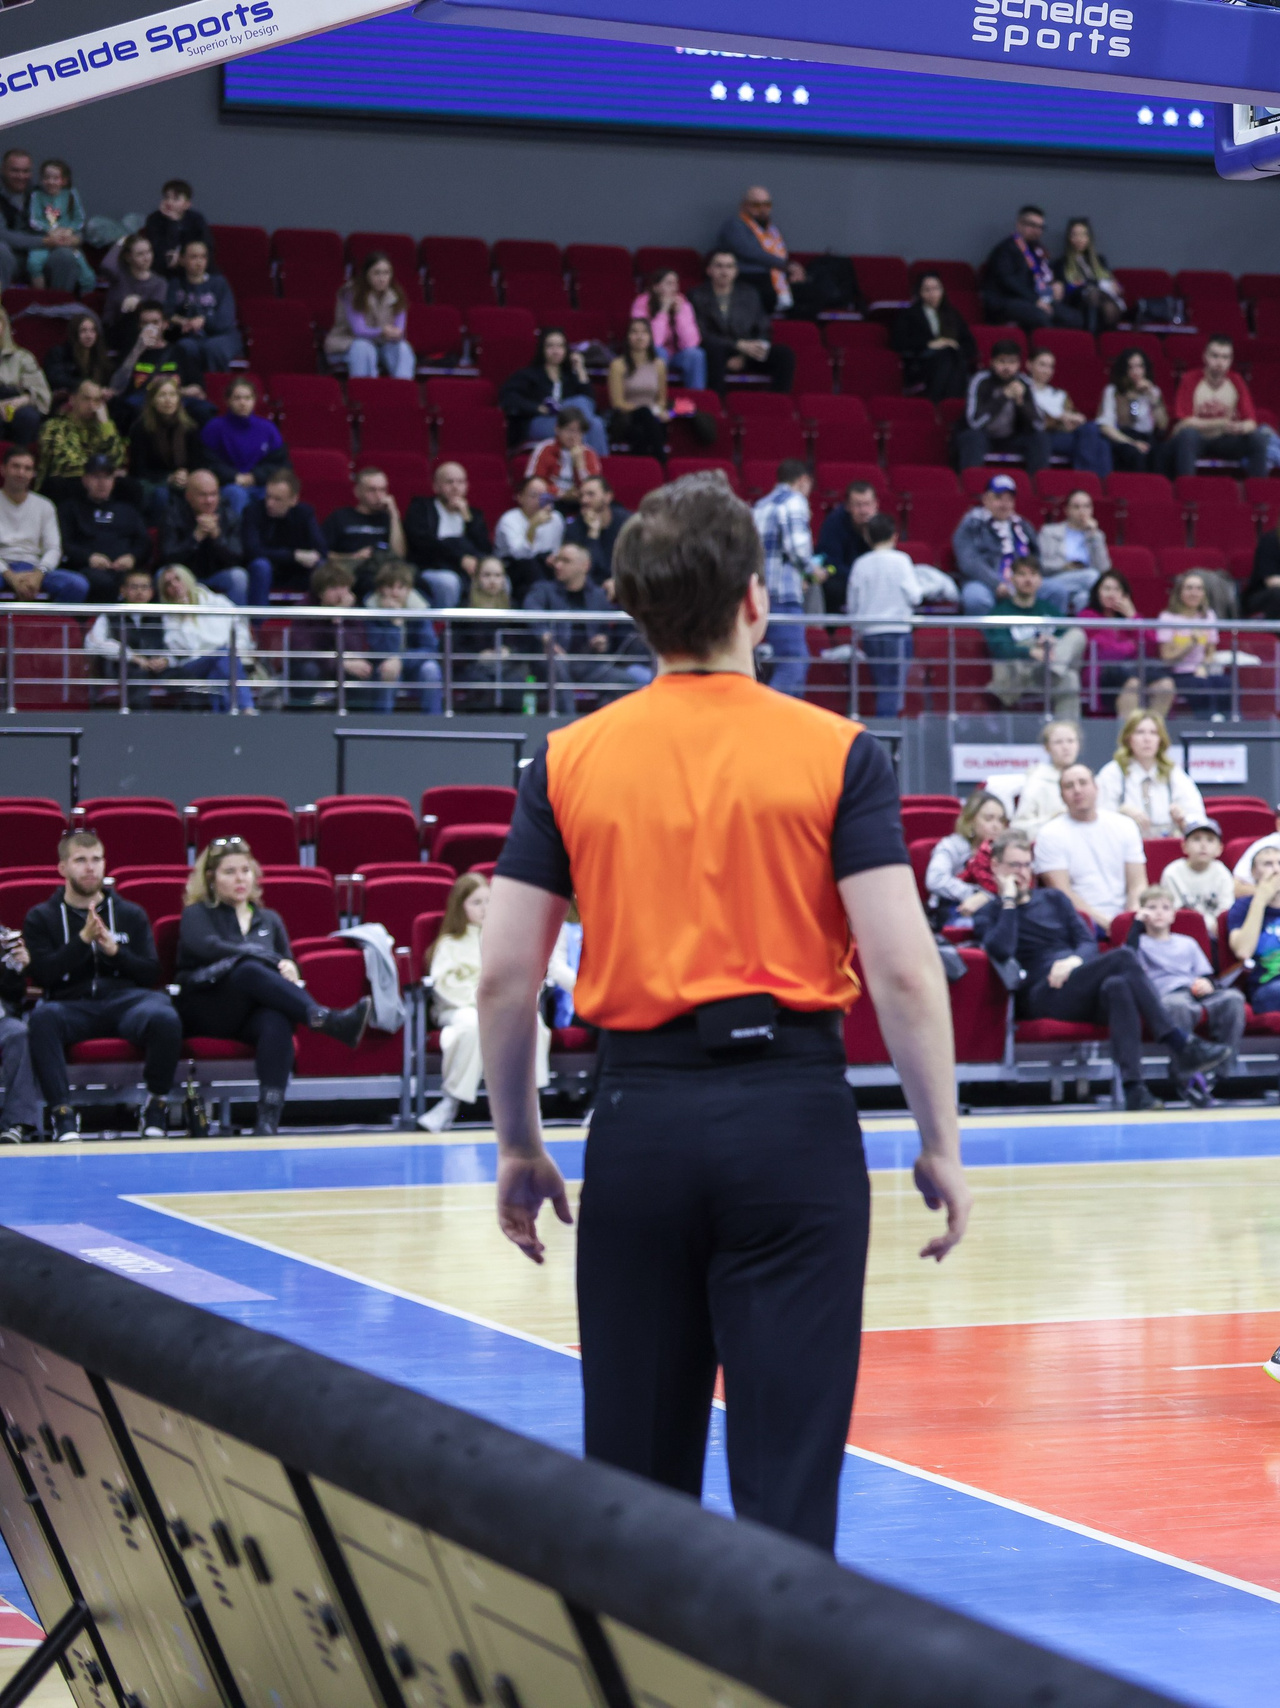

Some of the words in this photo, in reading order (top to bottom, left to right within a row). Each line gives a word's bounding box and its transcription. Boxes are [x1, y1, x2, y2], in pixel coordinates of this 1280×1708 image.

[145, 1, 274, 53] Sports
[187, 38, 228, 56] Superior
[231, 34, 243, 45] by
[244, 24, 279, 40] Design
[972, 15, 1131, 58] Sports
